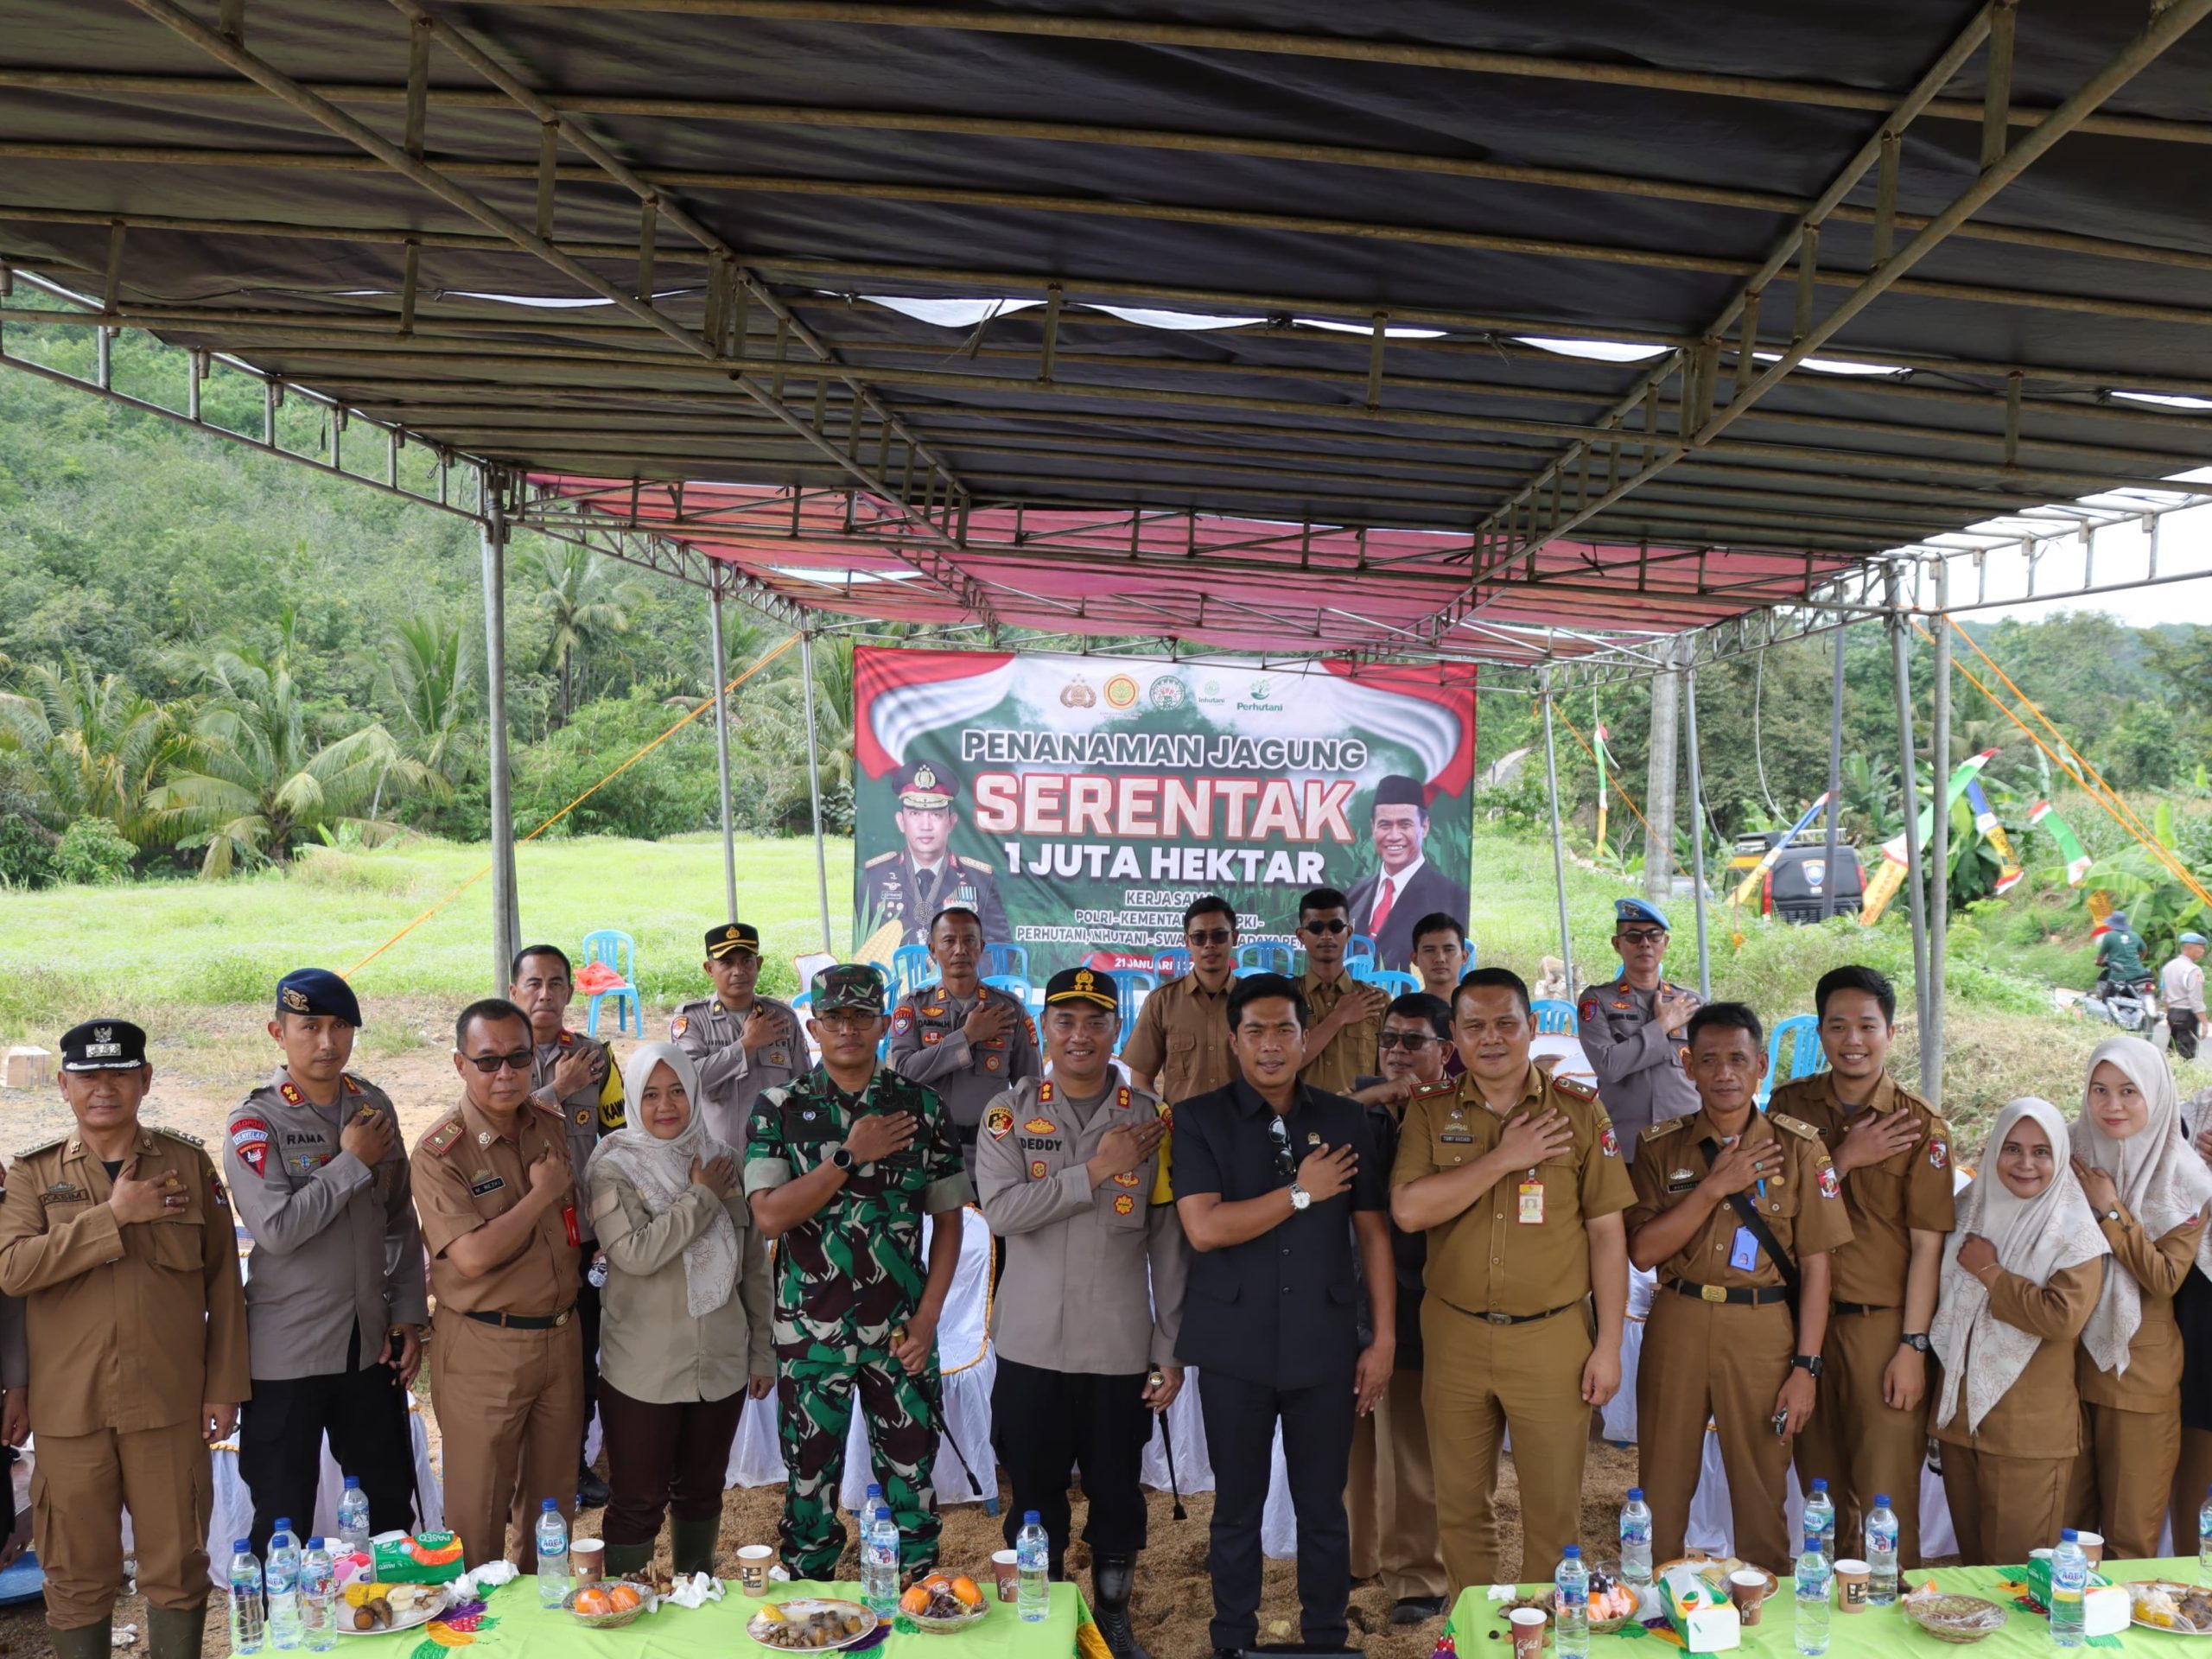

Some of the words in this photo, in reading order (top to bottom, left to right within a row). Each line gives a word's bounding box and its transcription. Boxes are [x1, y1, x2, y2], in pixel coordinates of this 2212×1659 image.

[1236, 702, 1283, 712] Perhutani
[962, 730, 1205, 766] PENANAMAN
[1210, 737, 1367, 771] JAGUNG
[973, 772, 1357, 843] SERENTAK
[1004, 842, 1020, 874] 1
[1028, 843, 1142, 879] JUTA
[1150, 847, 1325, 884] HEKTAR
[1115, 957, 1126, 967] 21
[287, 1134, 326, 1145] RAMA
[1020, 1137, 1063, 1152] DEDDY
[418, 1534, 451, 1542] PASEO
[543, 1538, 563, 1547] AQUA
[2062, 1572, 2083, 1580] AQUA
